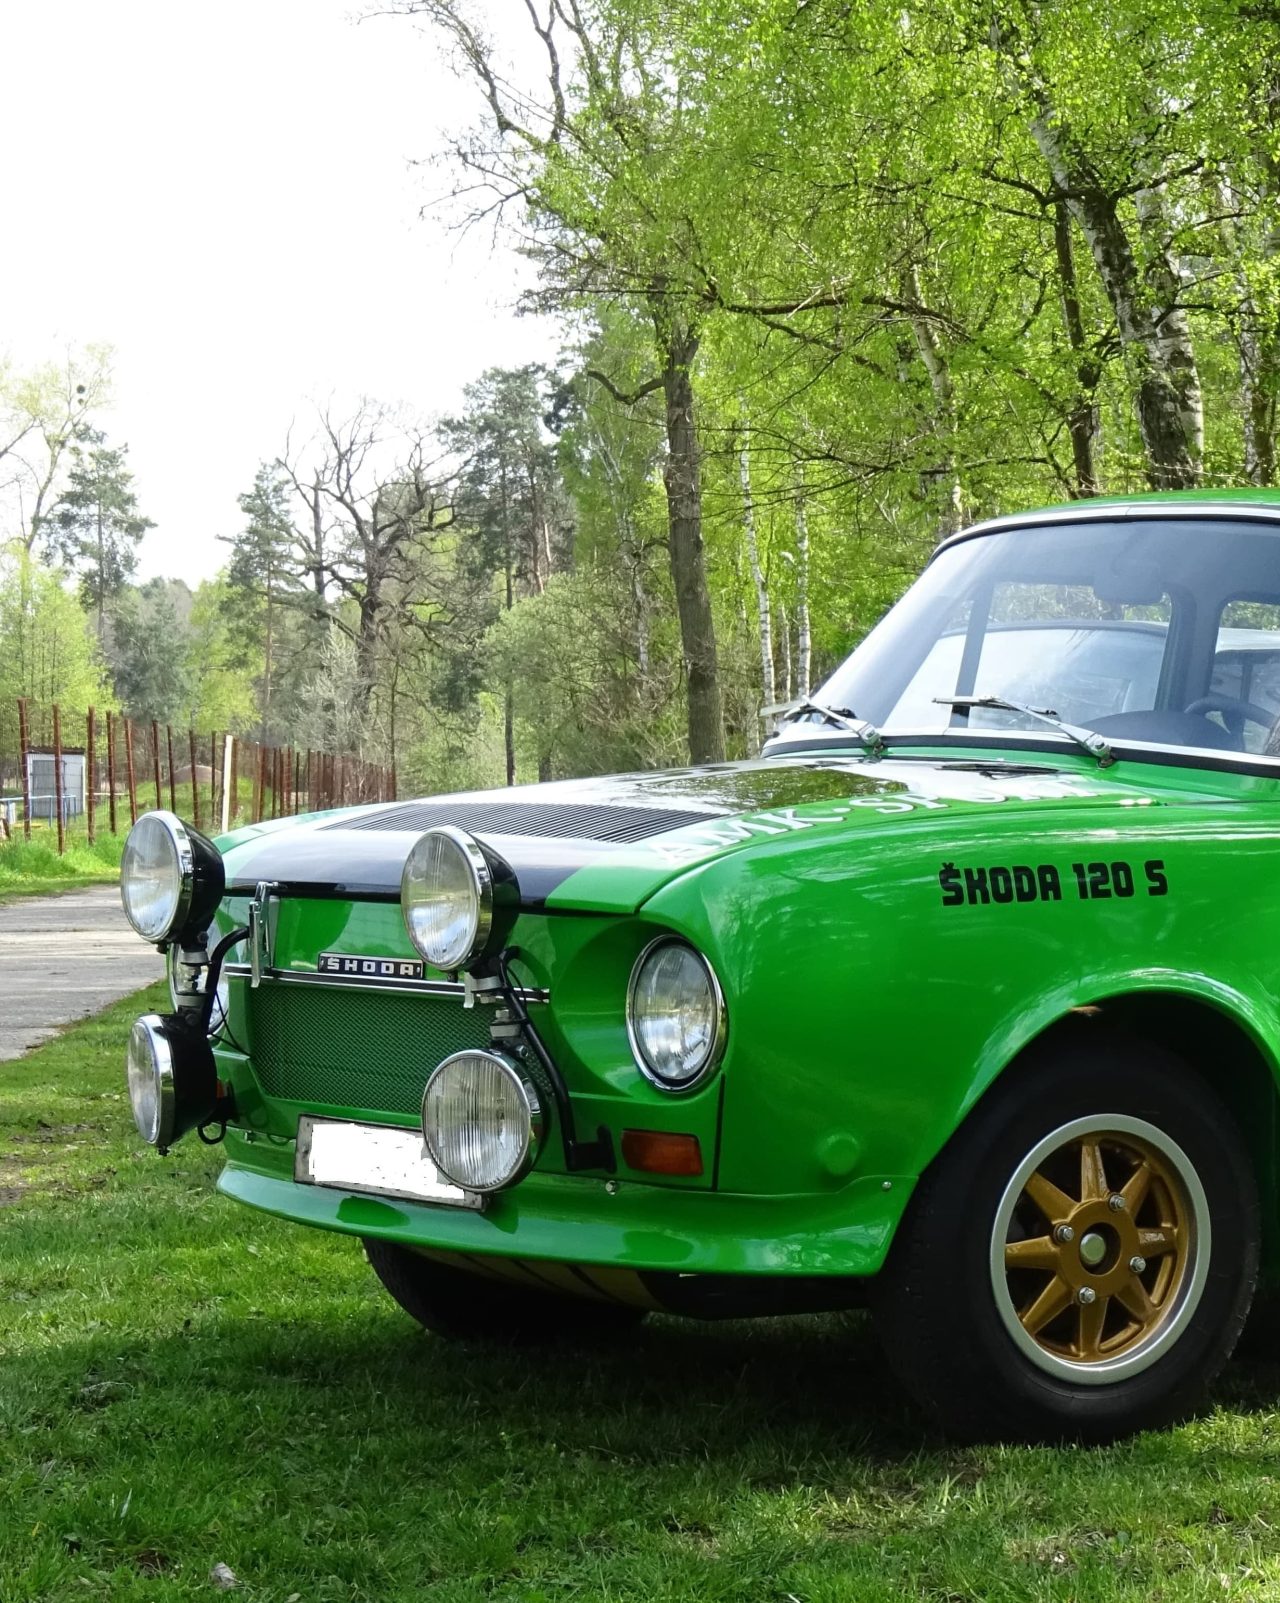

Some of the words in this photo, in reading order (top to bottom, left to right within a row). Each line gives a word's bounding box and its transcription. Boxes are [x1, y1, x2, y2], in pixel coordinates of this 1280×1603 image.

[938, 862, 1062, 906] ŠKODA
[1072, 861, 1135, 899] 120
[1144, 859, 1168, 896] S
